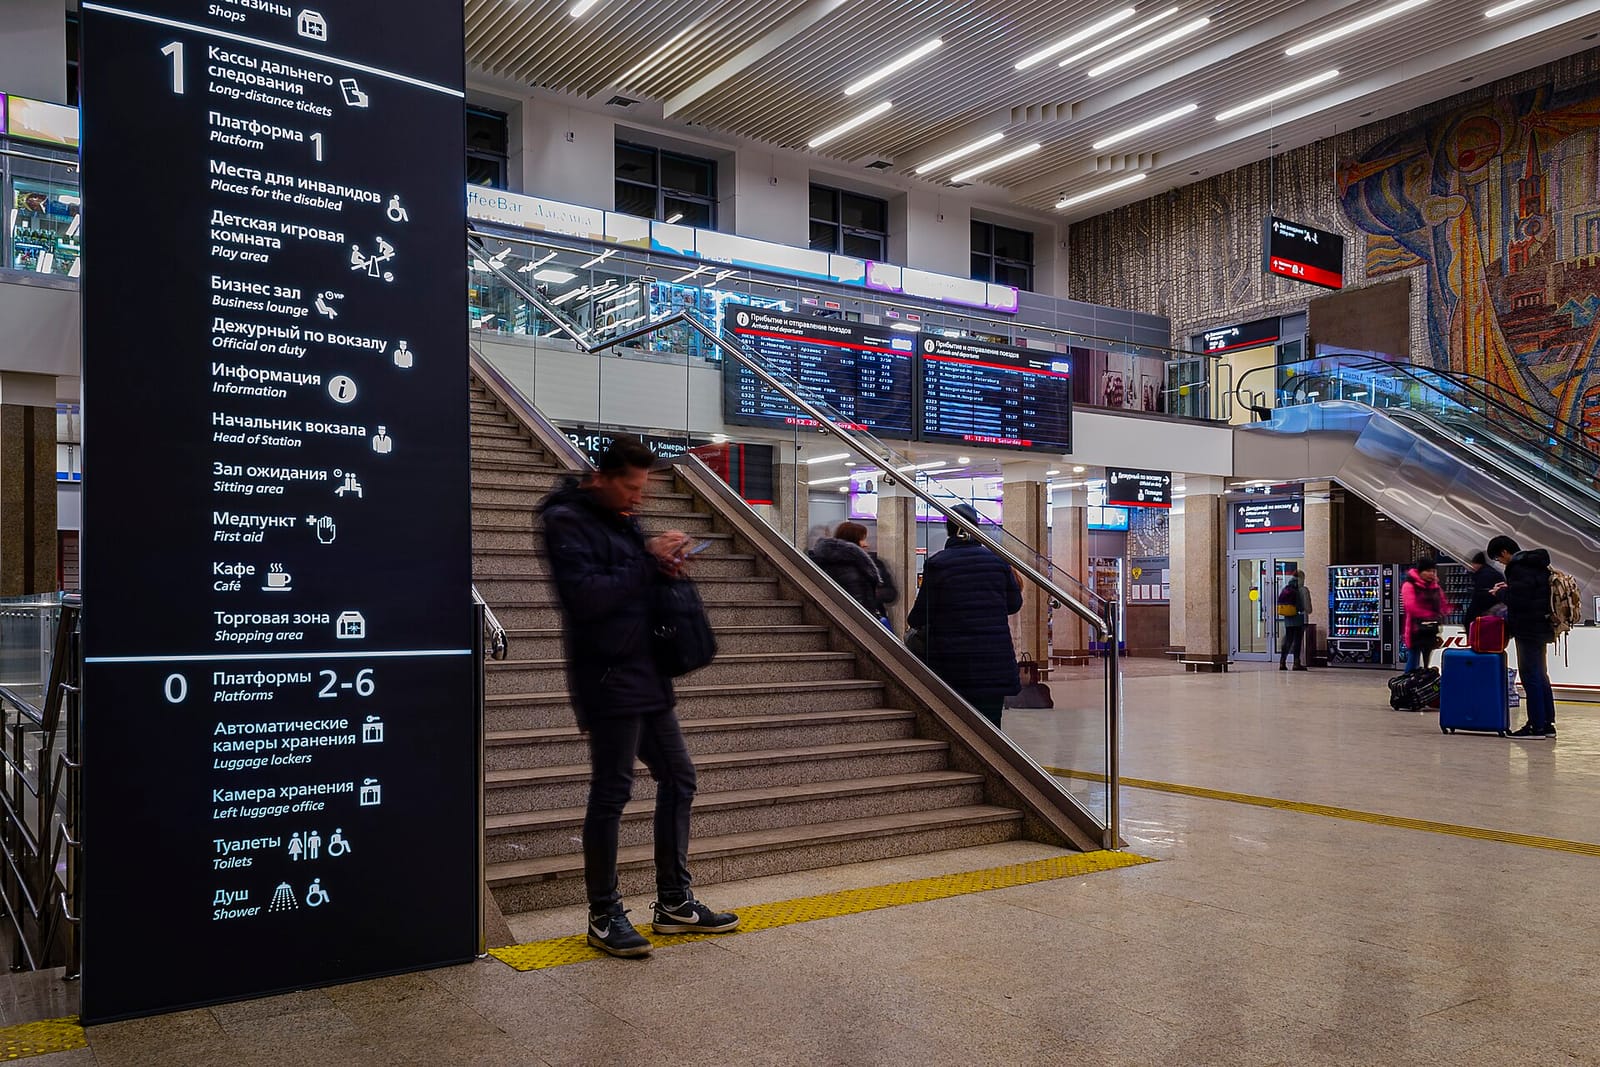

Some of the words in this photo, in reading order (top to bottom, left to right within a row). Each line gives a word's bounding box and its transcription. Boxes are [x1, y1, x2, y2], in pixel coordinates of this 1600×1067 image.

[208, 5, 247, 22] Shops
[225, 0, 292, 18] азины
[161, 42, 184, 94] 1
[208, 46, 257, 68] Кассы
[261, 60, 334, 86] дальнего
[208, 64, 304, 95] следования
[209, 82, 294, 109] Long-distance
[296, 101, 333, 116] tickets
[209, 111, 303, 142] Платформа
[310, 132, 322, 162] 1
[210, 131, 264, 150] Platform
[210, 160, 261, 181] Места
[265, 172, 294, 187] для
[298, 178, 381, 203] инвалидов
[210, 180, 248, 196] Places
[251, 186, 269, 199] for
[271, 189, 291, 202] the
[294, 192, 342, 211] disabled
[211, 210, 277, 232] Детская
[281, 224, 345, 243] игровая
[211, 229, 281, 249] комната
[211, 246, 238, 260] Play
[240, 251, 269, 263] area
[211, 275, 270, 296] Бизнес
[274, 285, 301, 300] зал
[212, 295, 264, 311] Business
[266, 303, 309, 317] lounge
[750, 313, 782, 325] Прибытие
[789, 321, 827, 333] отправление
[828, 325, 852, 335] поездов
[212, 318, 300, 340] Дежурный
[304, 330, 324, 342] по
[328, 334, 387, 353] вокзалу
[212, 337, 258, 351] Official
[260, 342, 276, 352] on
[279, 343, 306, 358] duty
[935, 340, 962, 350] Прибытие
[967, 345, 999, 356] отправление
[212, 362, 321, 386] Информация
[213, 382, 287, 398] Information
[212, 412, 302, 431] Начальник
[306, 422, 366, 436] вокзала
[213, 432, 245, 444] Head
[247, 433, 261, 445] of
[261, 435, 302, 448] Station
[213, 462, 243, 476] Зал
[247, 466, 327, 480] ожидания
[213, 481, 253, 495] Sitting
[256, 484, 284, 494] area
[213, 512, 296, 529] Медпункт
[213, 531, 241, 542] First
[243, 532, 264, 542] aid
[213, 562, 255, 578] Кафе
[213, 580, 241, 591] Café
[214, 611, 289, 628] Торговая
[293, 613, 330, 624] зона
[215, 631, 273, 643] Shopping
[275, 632, 303, 640] area
[164, 673, 188, 703] 0
[213, 671, 312, 687] Платформы
[318, 668, 375, 698] 2-6
[213, 690, 274, 702] Platforms
[214, 718, 349, 735] Автоматические
[213, 737, 278, 753] камеры
[281, 734, 356, 751] хранения
[213, 756, 268, 771] Luggage
[271, 753, 312, 766] lockers
[213, 786, 276, 802] Камера
[280, 781, 354, 798] хранения
[213, 806, 237, 819] Left
[240, 803, 289, 818] luggage
[292, 800, 325, 813] office
[213, 836, 281, 855] Туалеты
[213, 856, 252, 870] Toilets
[213, 889, 249, 906] Душ
[213, 905, 260, 921] Shower
